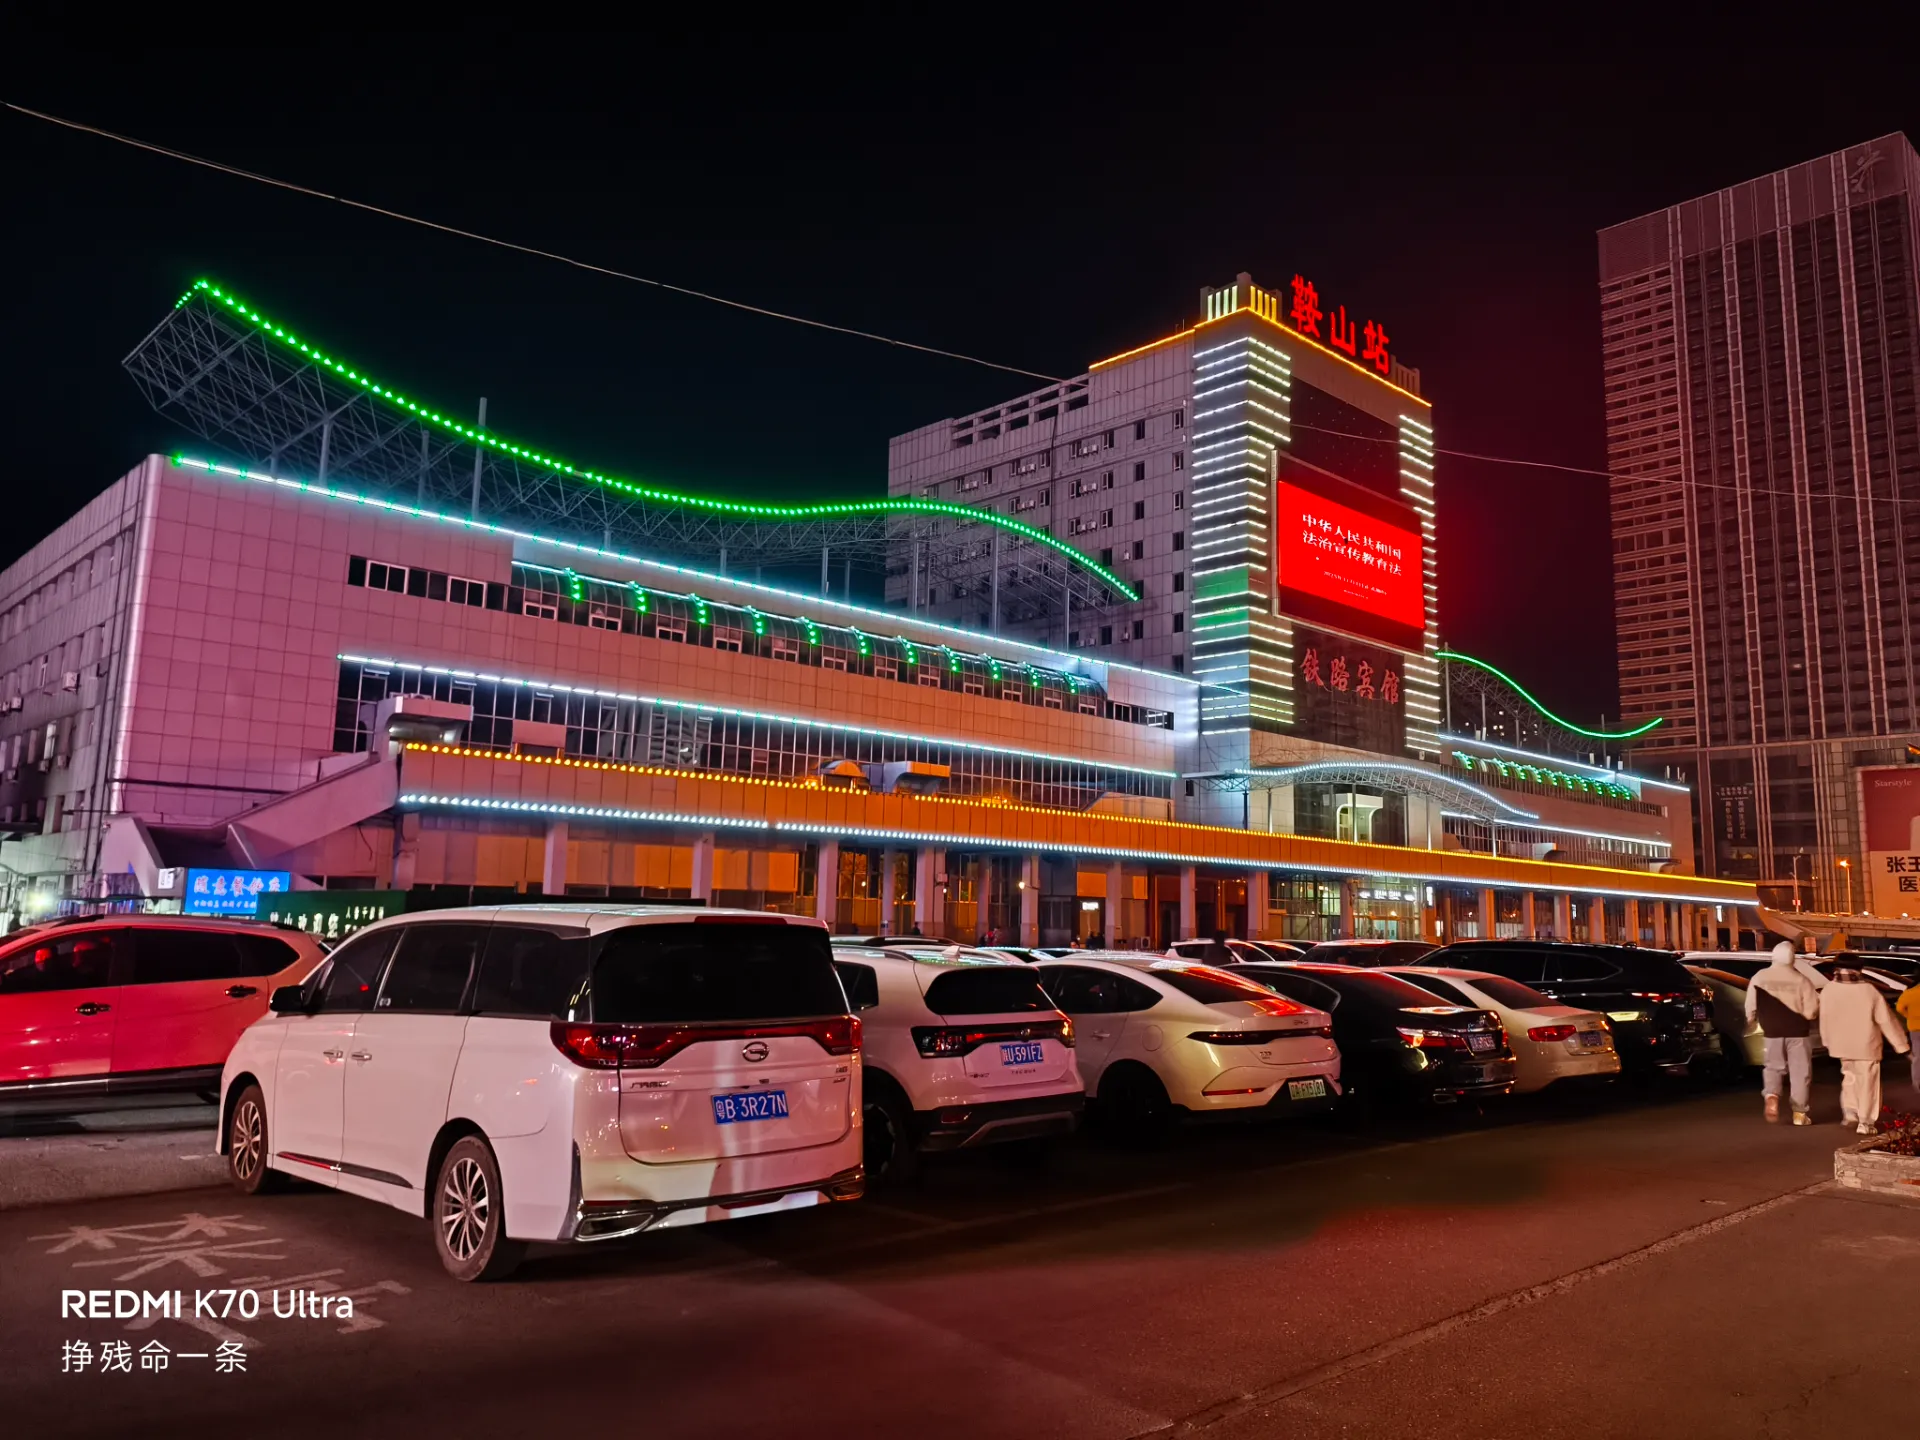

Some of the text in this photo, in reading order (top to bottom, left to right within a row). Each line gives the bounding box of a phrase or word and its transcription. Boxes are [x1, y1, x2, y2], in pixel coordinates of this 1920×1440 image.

[1290, 273, 1389, 374] 鞍山站
[1302, 513, 1401, 561] 中华人民共和国
[1302, 530, 1402, 576] 法治宣传教育法
[1300, 648, 1400, 704] 铁路宾馆
[1874, 779, 1912, 788] Starstyle
[1898, 876, 1920, 893] 医
